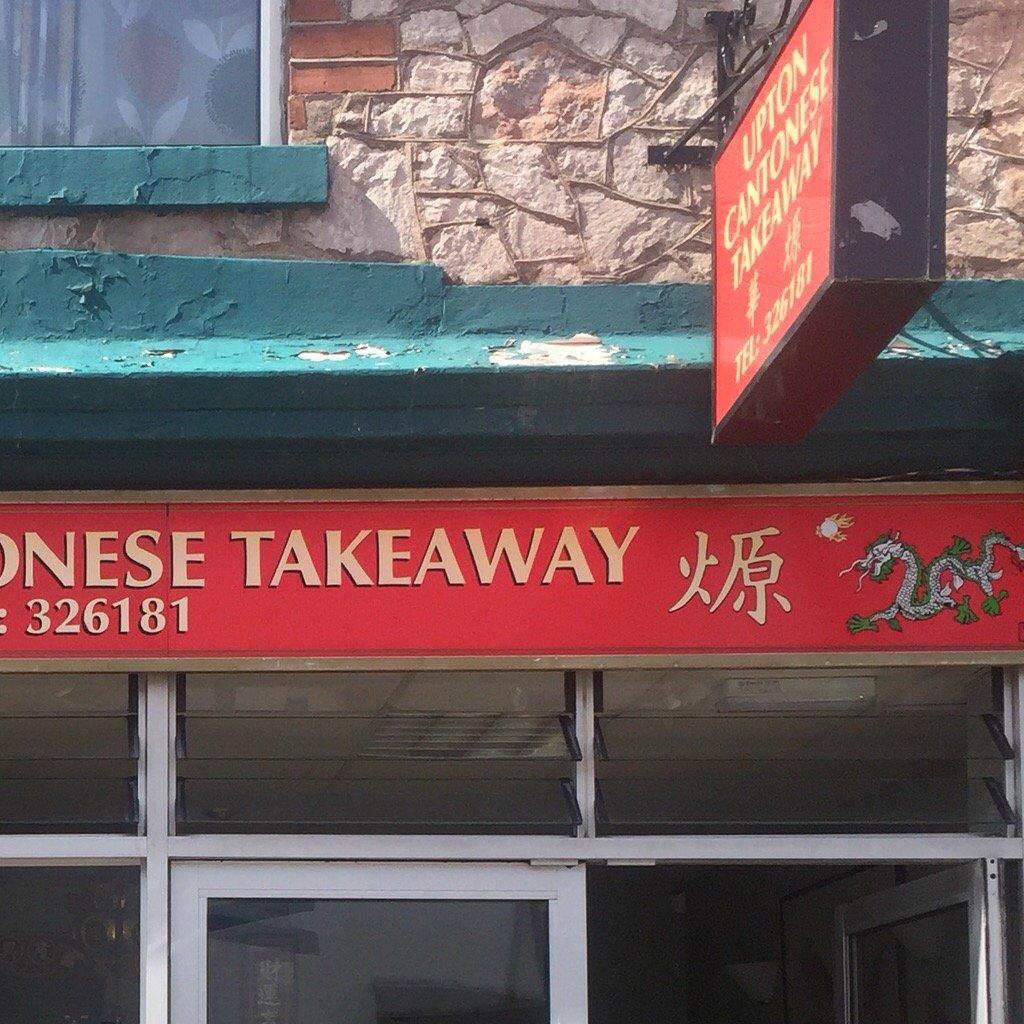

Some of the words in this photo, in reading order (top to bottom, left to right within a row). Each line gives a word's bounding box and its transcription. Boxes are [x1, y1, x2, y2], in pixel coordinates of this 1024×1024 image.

[724, 48, 830, 250] CANTONESE
[742, 33, 808, 171] UPTON
[731, 117, 823, 290] TAKEAWAY
[734, 332, 761, 383] TEL:
[763, 251, 813, 345] 326181
[26, 596, 189, 635] 326181
[231, 526, 640, 587] TAKEAWAY
